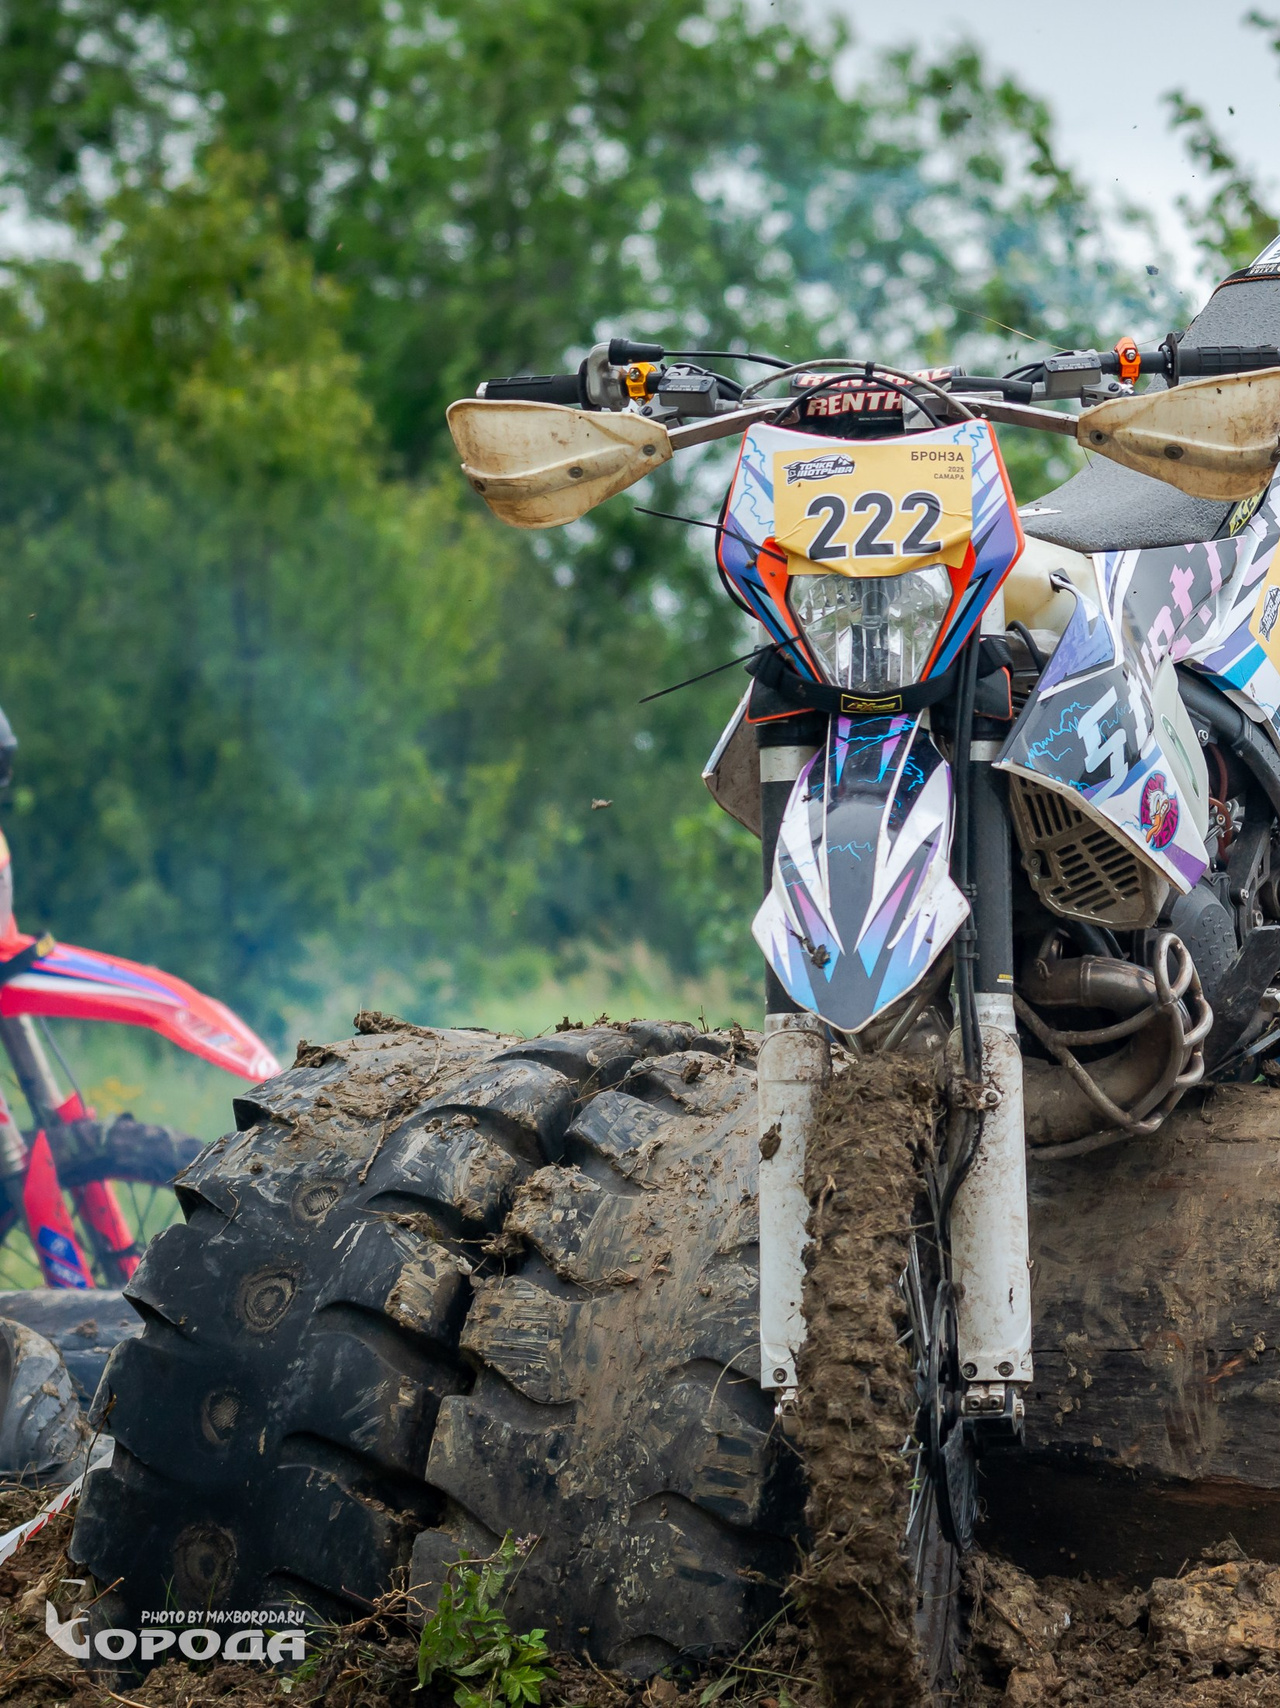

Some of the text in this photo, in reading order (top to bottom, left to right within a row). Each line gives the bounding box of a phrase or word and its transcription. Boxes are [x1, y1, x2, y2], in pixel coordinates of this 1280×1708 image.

[806, 391, 903, 417] RENTH
[911, 451, 965, 462] БРОНЗА
[805, 491, 944, 561] 222
